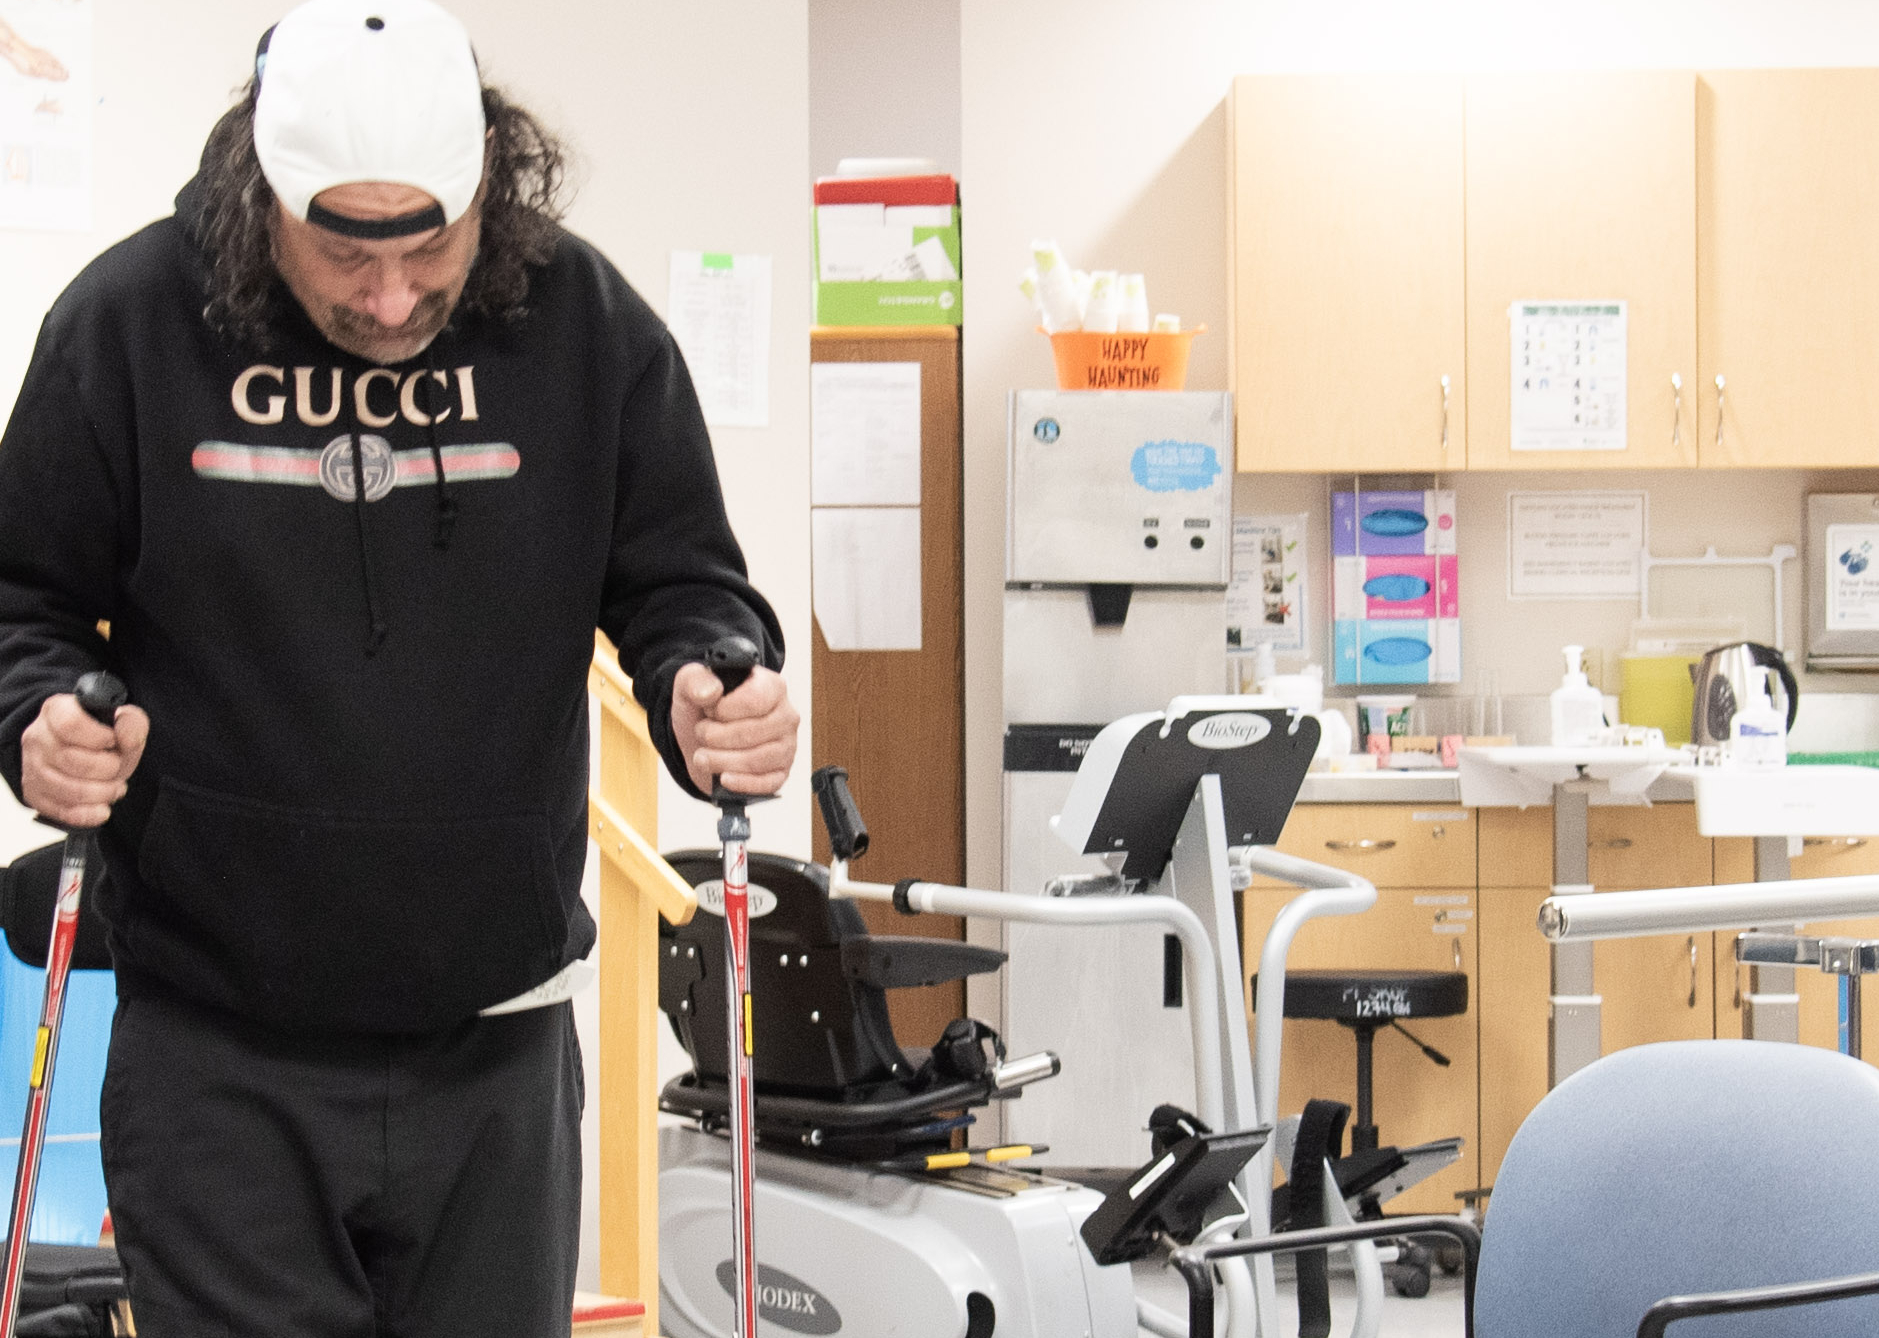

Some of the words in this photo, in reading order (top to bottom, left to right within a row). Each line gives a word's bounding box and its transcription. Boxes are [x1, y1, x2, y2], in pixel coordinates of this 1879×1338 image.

[1102, 338, 1149, 361] HAPPY
[1088, 365, 1160, 388] HAUNTING
[231, 364, 480, 428] GUCCI
[1202, 721, 1259, 740] BioStep
